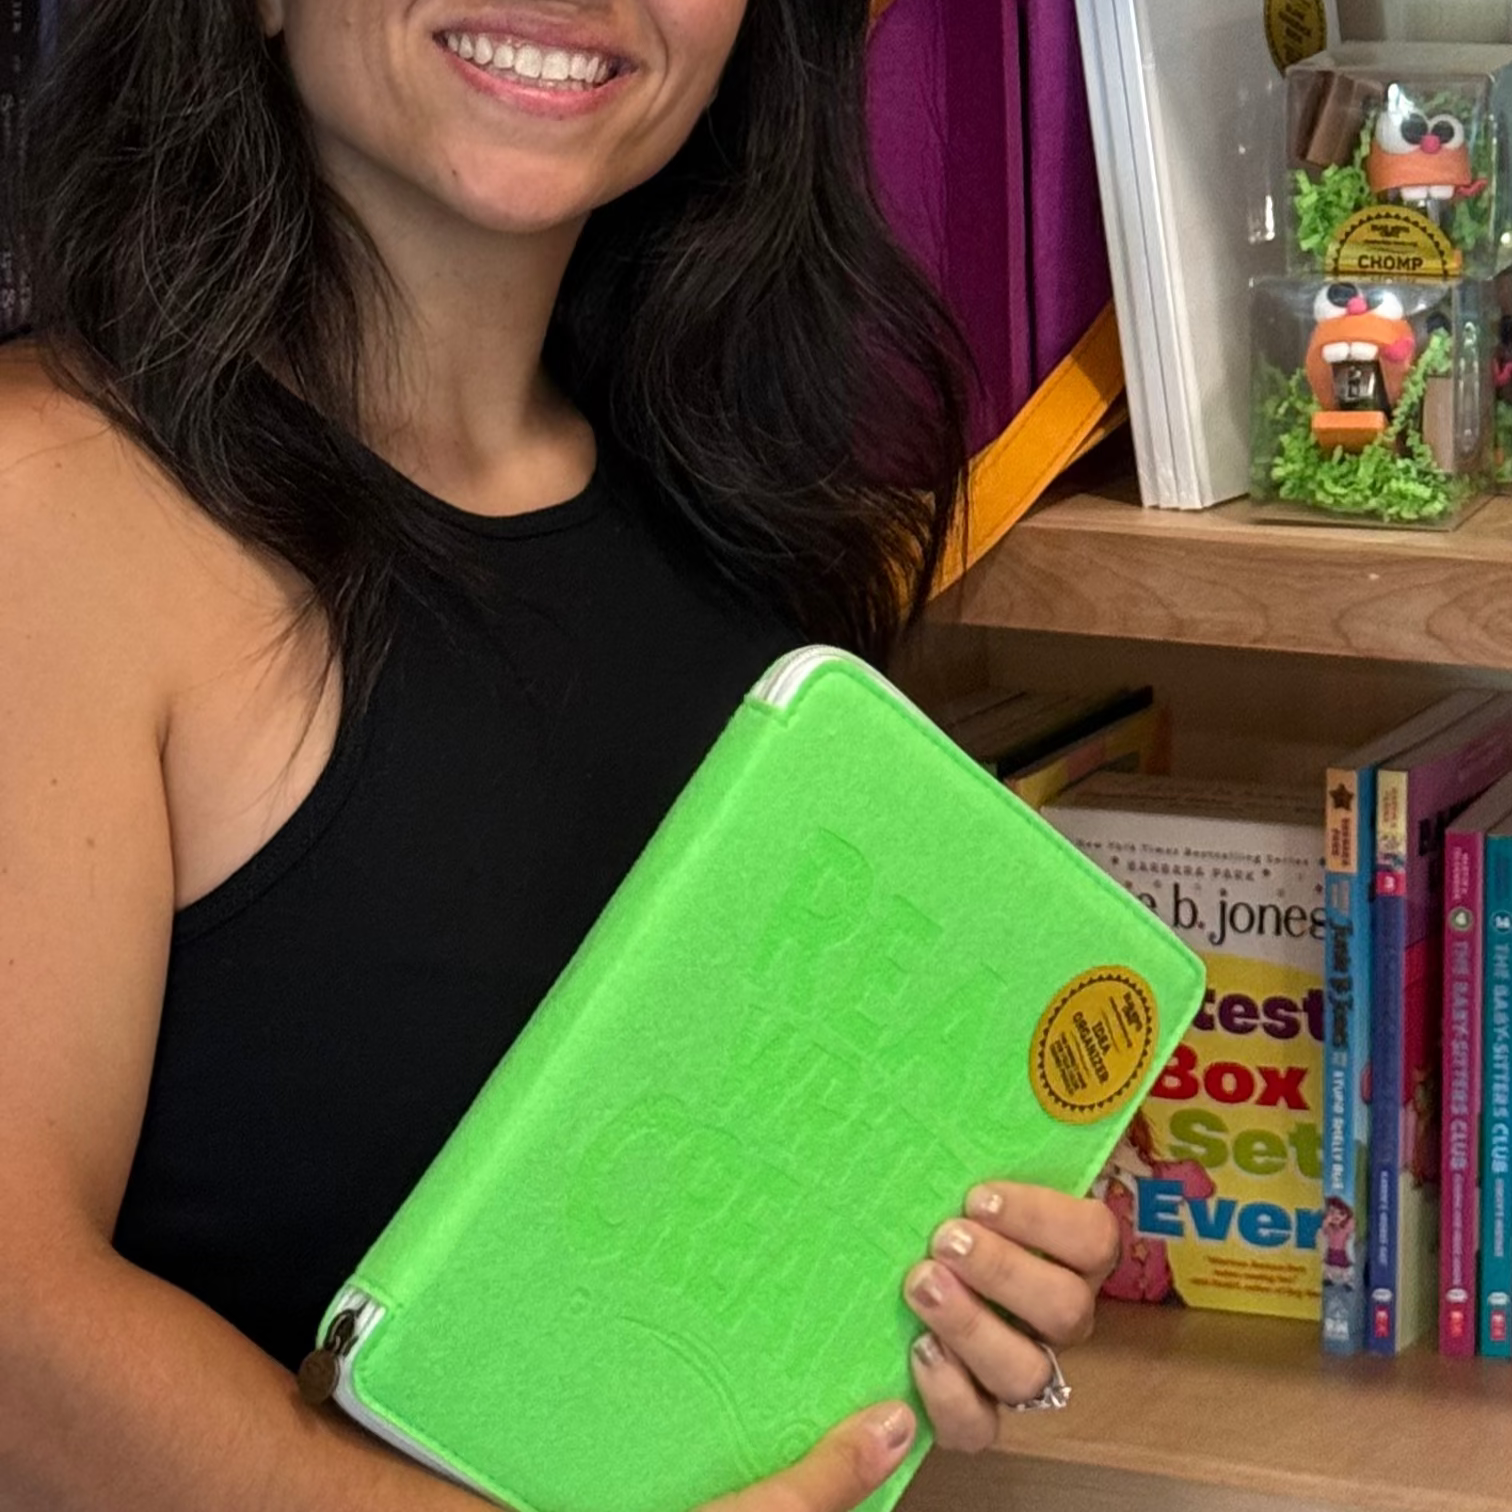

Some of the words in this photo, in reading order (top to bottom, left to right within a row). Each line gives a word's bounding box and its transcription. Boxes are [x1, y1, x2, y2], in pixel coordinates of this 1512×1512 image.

[1357, 254, 1424, 271] CHOMP
[1126, 860, 1205, 878] BARBARA
[1211, 867, 1255, 882] PARK
[1141, 843, 1179, 856] Times
[1183, 845, 1262, 865] Bestselling
[1266, 853, 1309, 867] Series
[1208, 888, 1327, 946] jones
[1451, 940, 1471, 976] THE
[1493, 943, 1510, 979] THE
[1091, 1020, 1111, 1056] IDEA
[1191, 987, 1325, 1043] test
[1072, 1010, 1110, 1085] ORGANIZER
[1450, 980, 1470, 1116] BABY-SITTERS
[1492, 984, 1511, 1118] BABY-SITTERS
[1150, 1042, 1310, 1111] Box
[1168, 1107, 1323, 1180] Set
[1449, 1119, 1468, 1170] CLUB
[1491, 1122, 1509, 1173] CLUB
[1136, 1176, 1324, 1250] Ever
